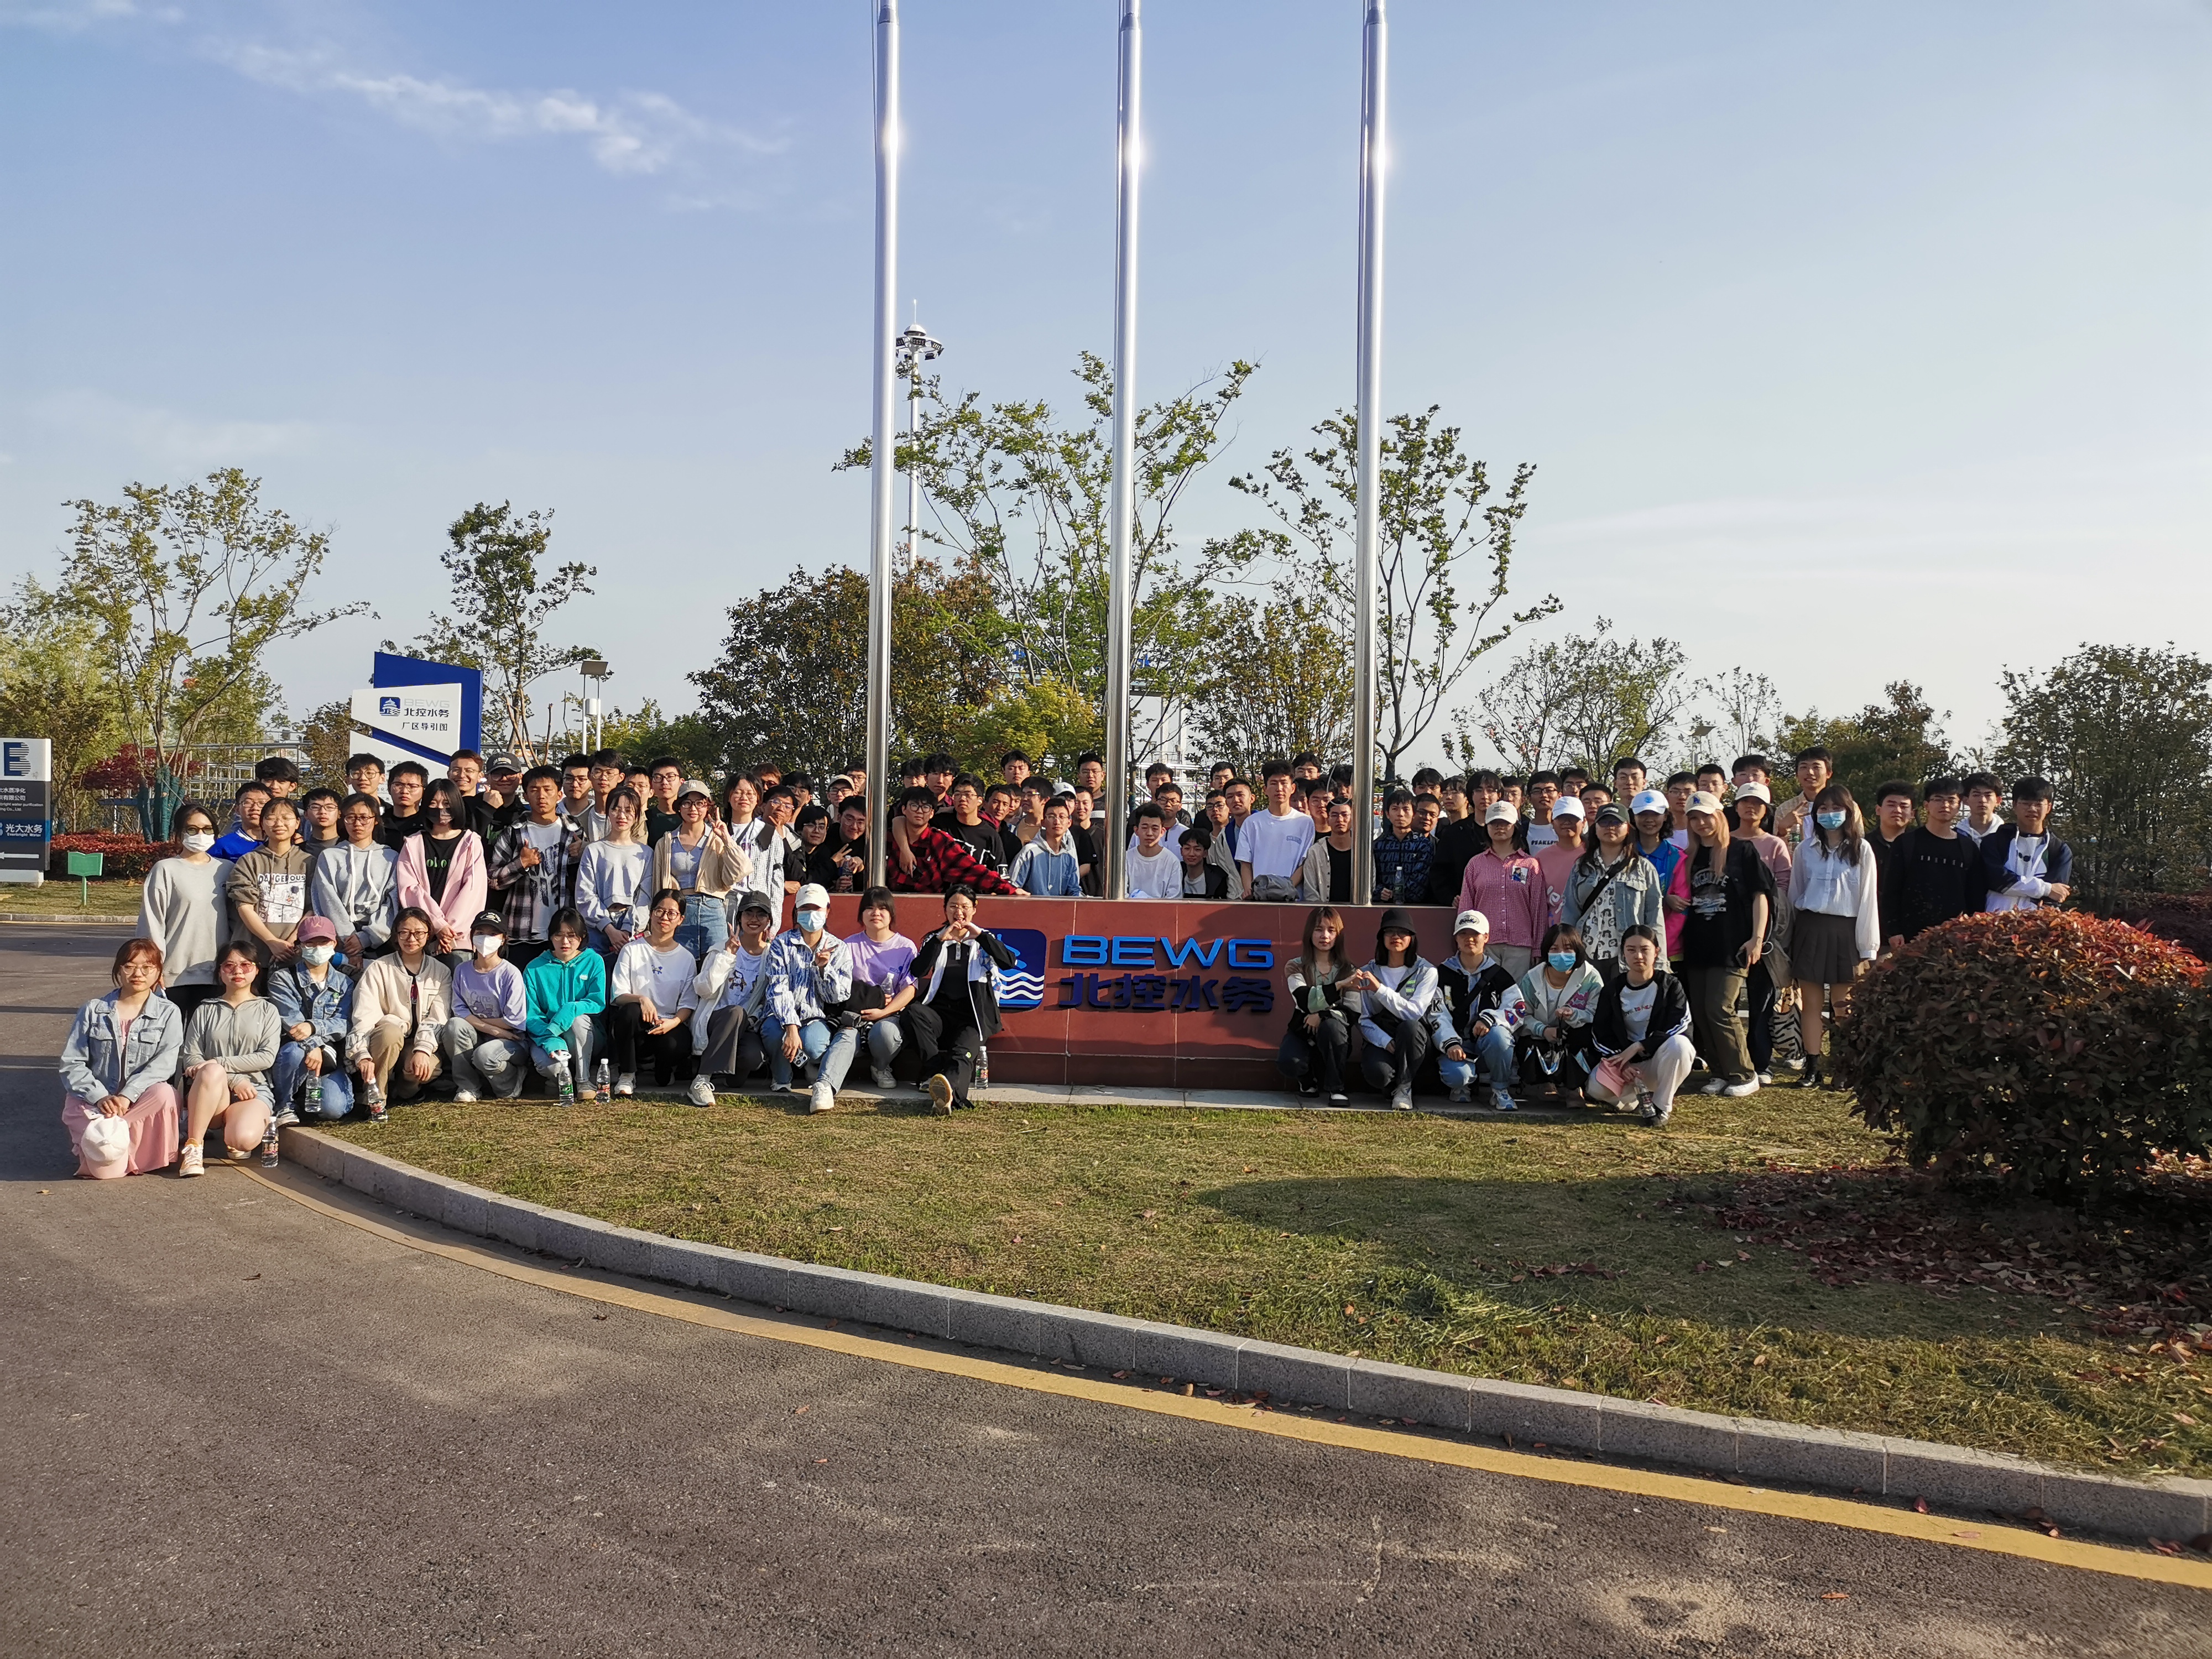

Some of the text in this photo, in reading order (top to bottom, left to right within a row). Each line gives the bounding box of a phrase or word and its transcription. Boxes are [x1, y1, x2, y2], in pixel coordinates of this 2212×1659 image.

[404, 698, 450, 708] BEWG
[404, 708, 450, 718] 北控水务
[401, 722, 447, 731] 厂区导引图
[6, 823, 43, 833] 光大水务
[1062, 934, 1274, 971] BEWG
[1058, 972, 1274, 1013] 北控水务
